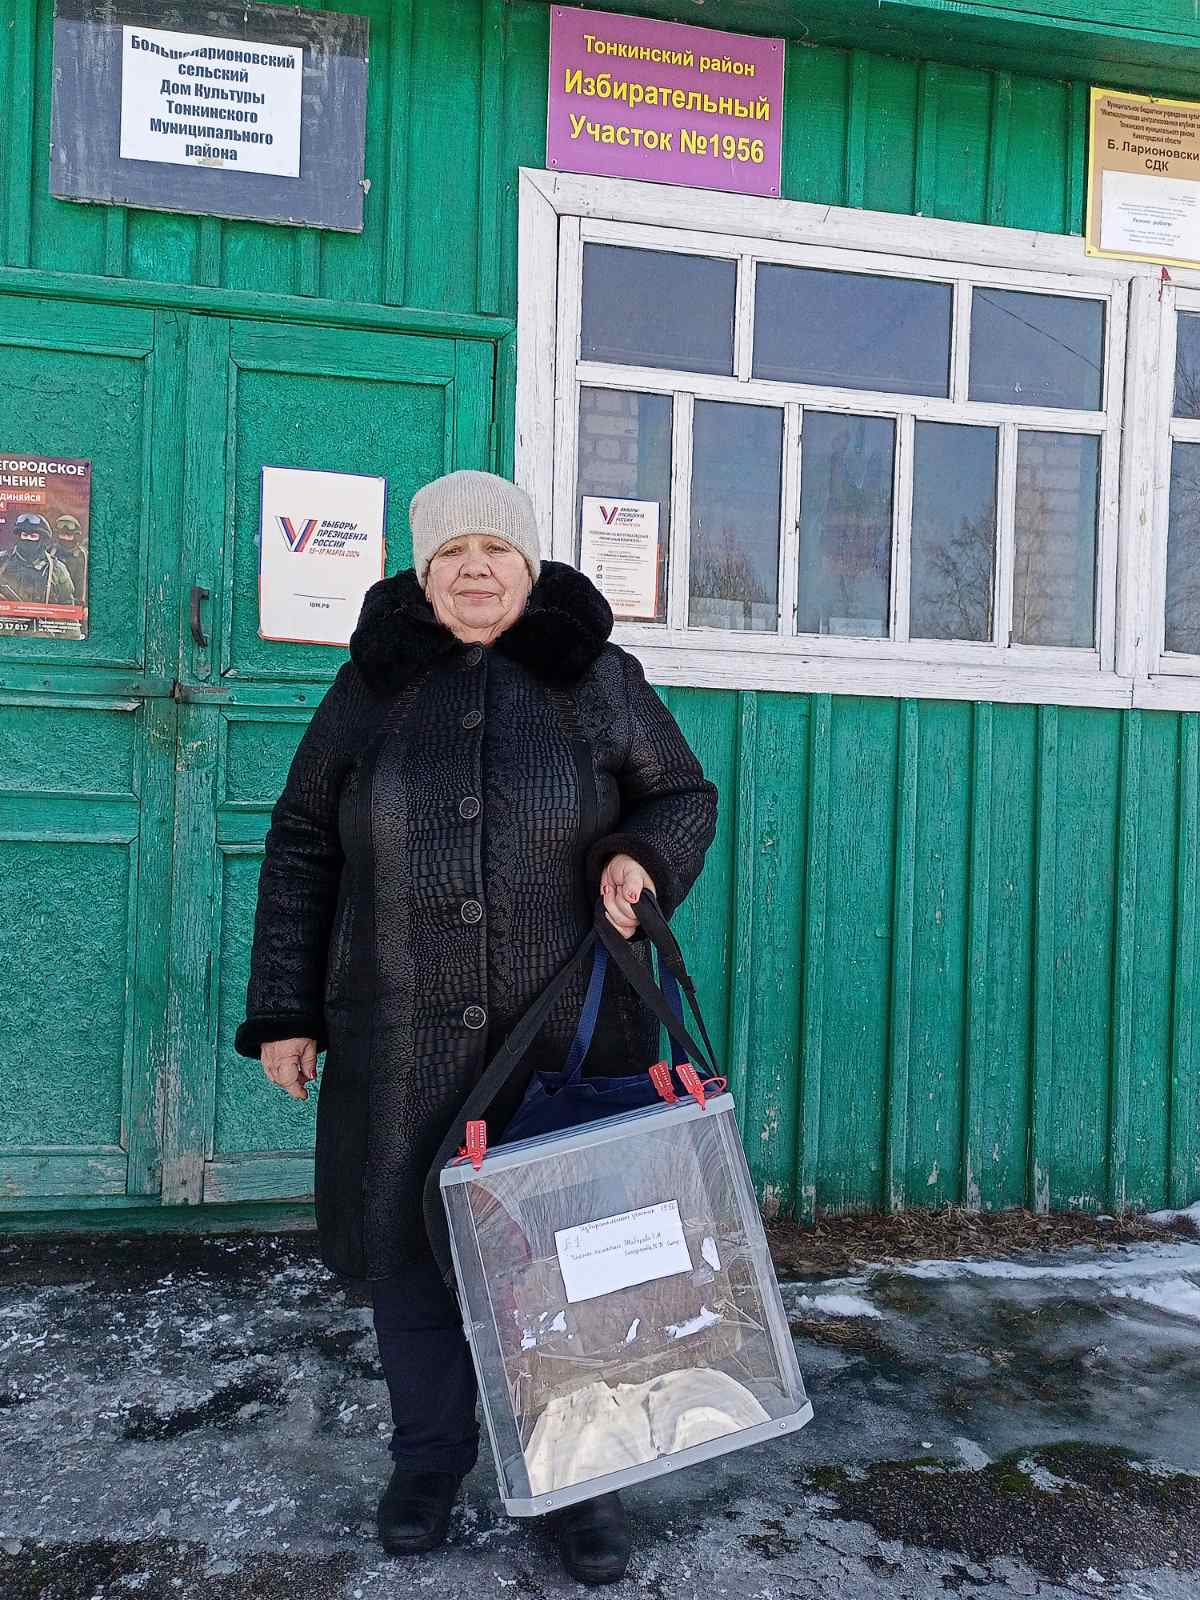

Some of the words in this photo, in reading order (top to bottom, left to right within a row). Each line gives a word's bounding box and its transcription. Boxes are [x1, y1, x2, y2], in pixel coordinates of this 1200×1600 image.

[583, 34, 694, 67] Тонкинский
[699, 57, 755, 77] район
[178, 63, 248, 83] сельский
[160, 79, 191, 97] Дом
[194, 83, 265, 105] Культуры
[564, 68, 770, 121] Избирательный
[166, 100, 258, 123] Тонкинского
[150, 118, 273, 145] Муниципального
[569, 113, 673, 151] Участок
[680, 129, 765, 164] №1956
[185, 144, 238, 161] района
[1107, 139, 1119, 151] Б.
[1145, 158, 1169, 172] СДК
[0, 475, 46, 488] ЧЕНИЕ
[321, 520, 358, 531] ВЫБОРЫ
[312, 538, 346, 548] РОССИИ
[317, 529, 368, 541] ПРЕЗИДЕНТА
